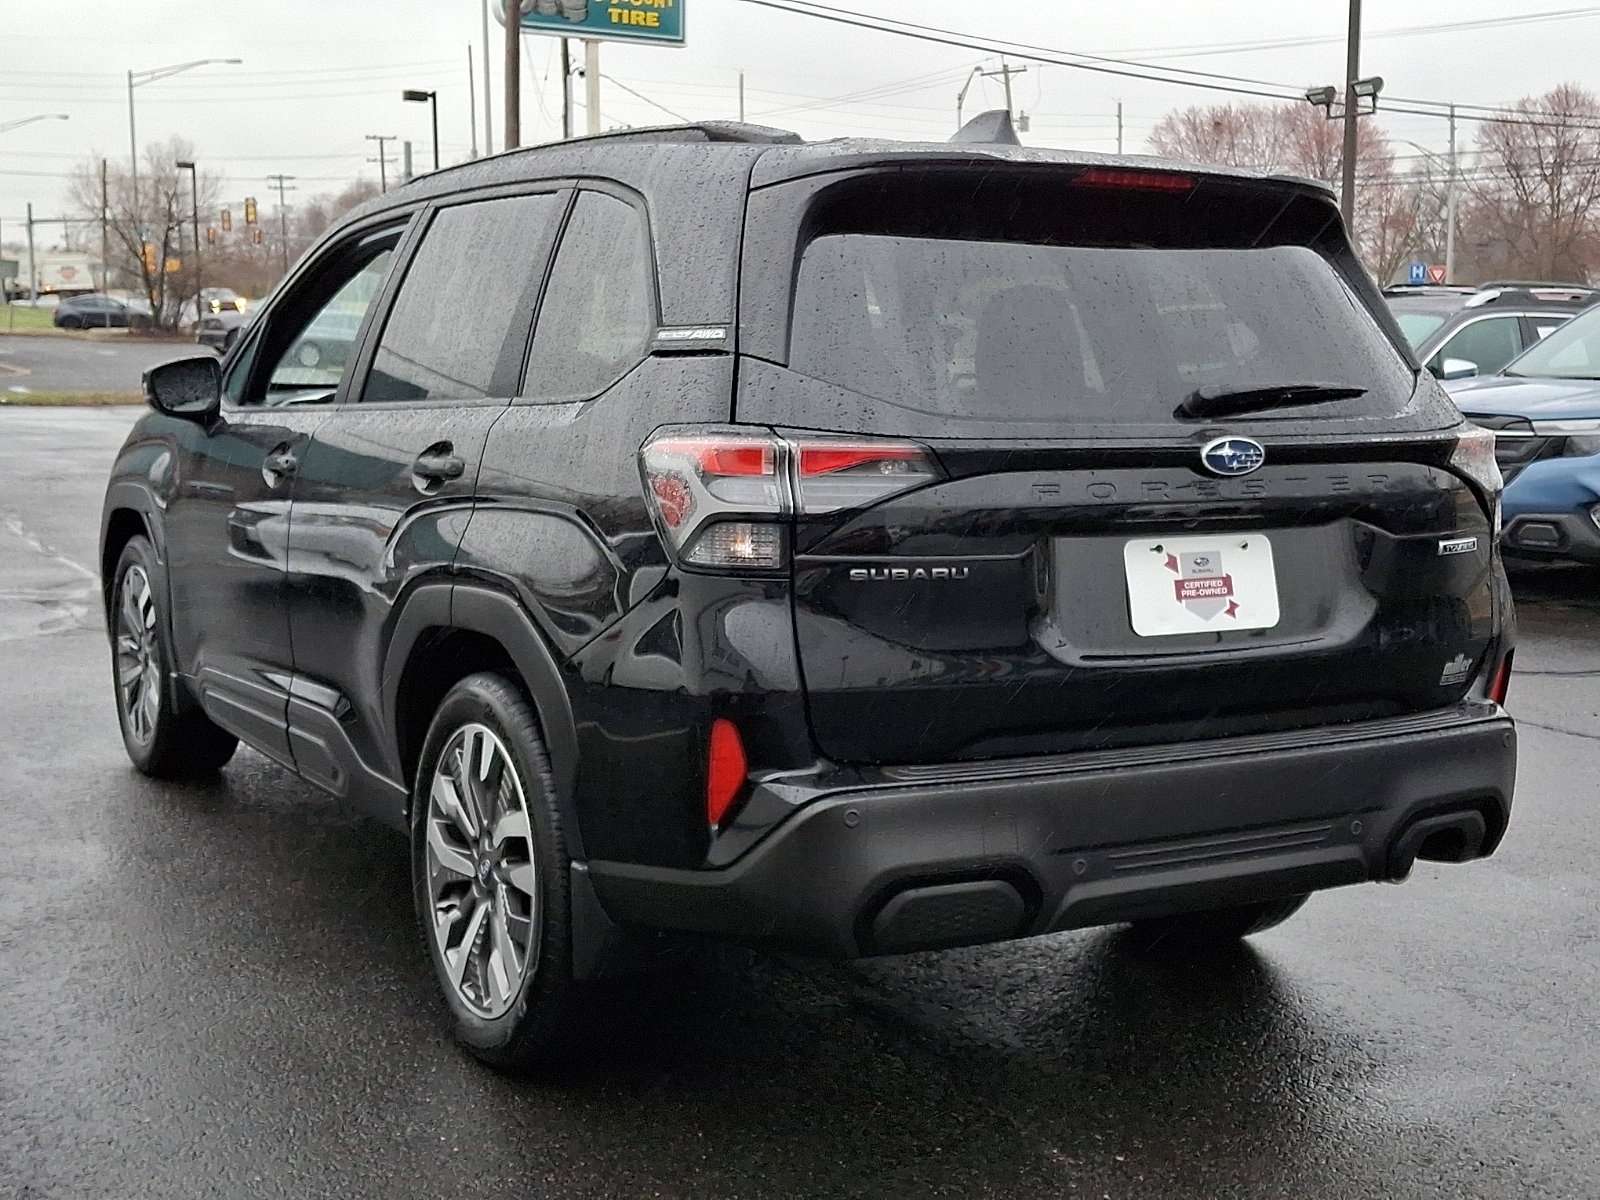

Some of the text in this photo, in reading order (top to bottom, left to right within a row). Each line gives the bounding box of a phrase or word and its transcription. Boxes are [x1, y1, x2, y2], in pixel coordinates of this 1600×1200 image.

[608, 8, 660, 27] TIRE
[1412, 265, 1424, 278] H
[849, 567, 969, 580] SUBARU
[1184, 580, 1223, 589] CERTIFIED
[1181, 588, 1228, 597] PRE-OWNED
